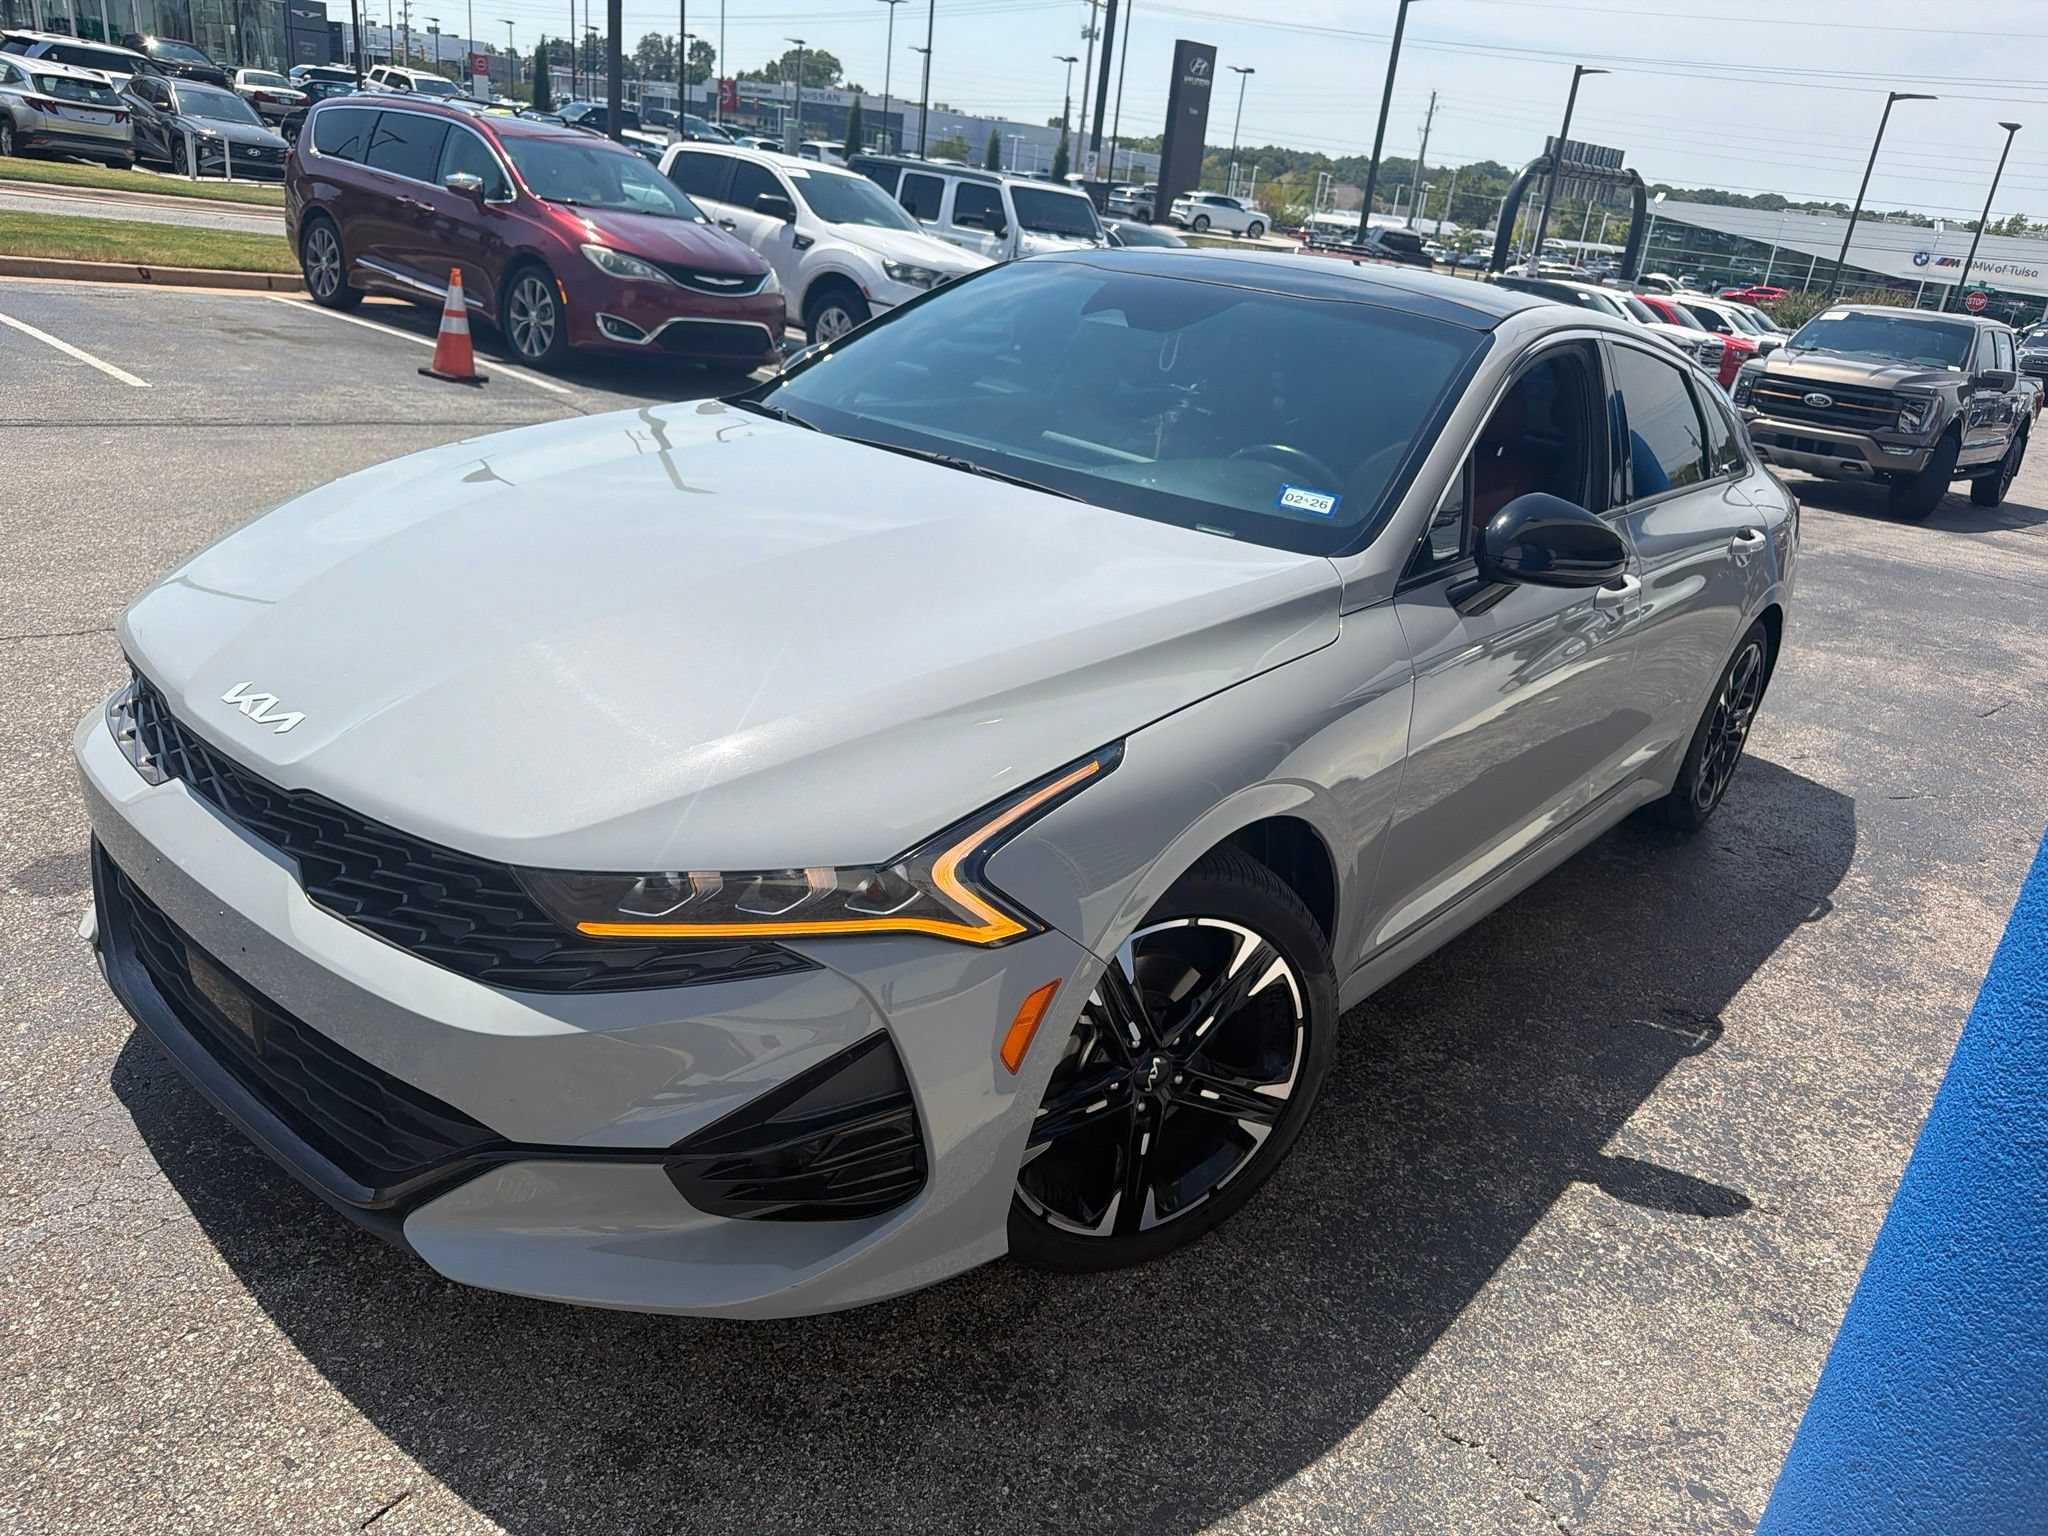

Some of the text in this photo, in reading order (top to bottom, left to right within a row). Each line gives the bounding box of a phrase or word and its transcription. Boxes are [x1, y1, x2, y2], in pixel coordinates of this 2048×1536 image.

[1995, 264, 2008, 274] of
[2009, 265, 2039, 278] Tulsa
[1967, 297, 1986, 306] STOP
[220, 681, 306, 734] KIA
